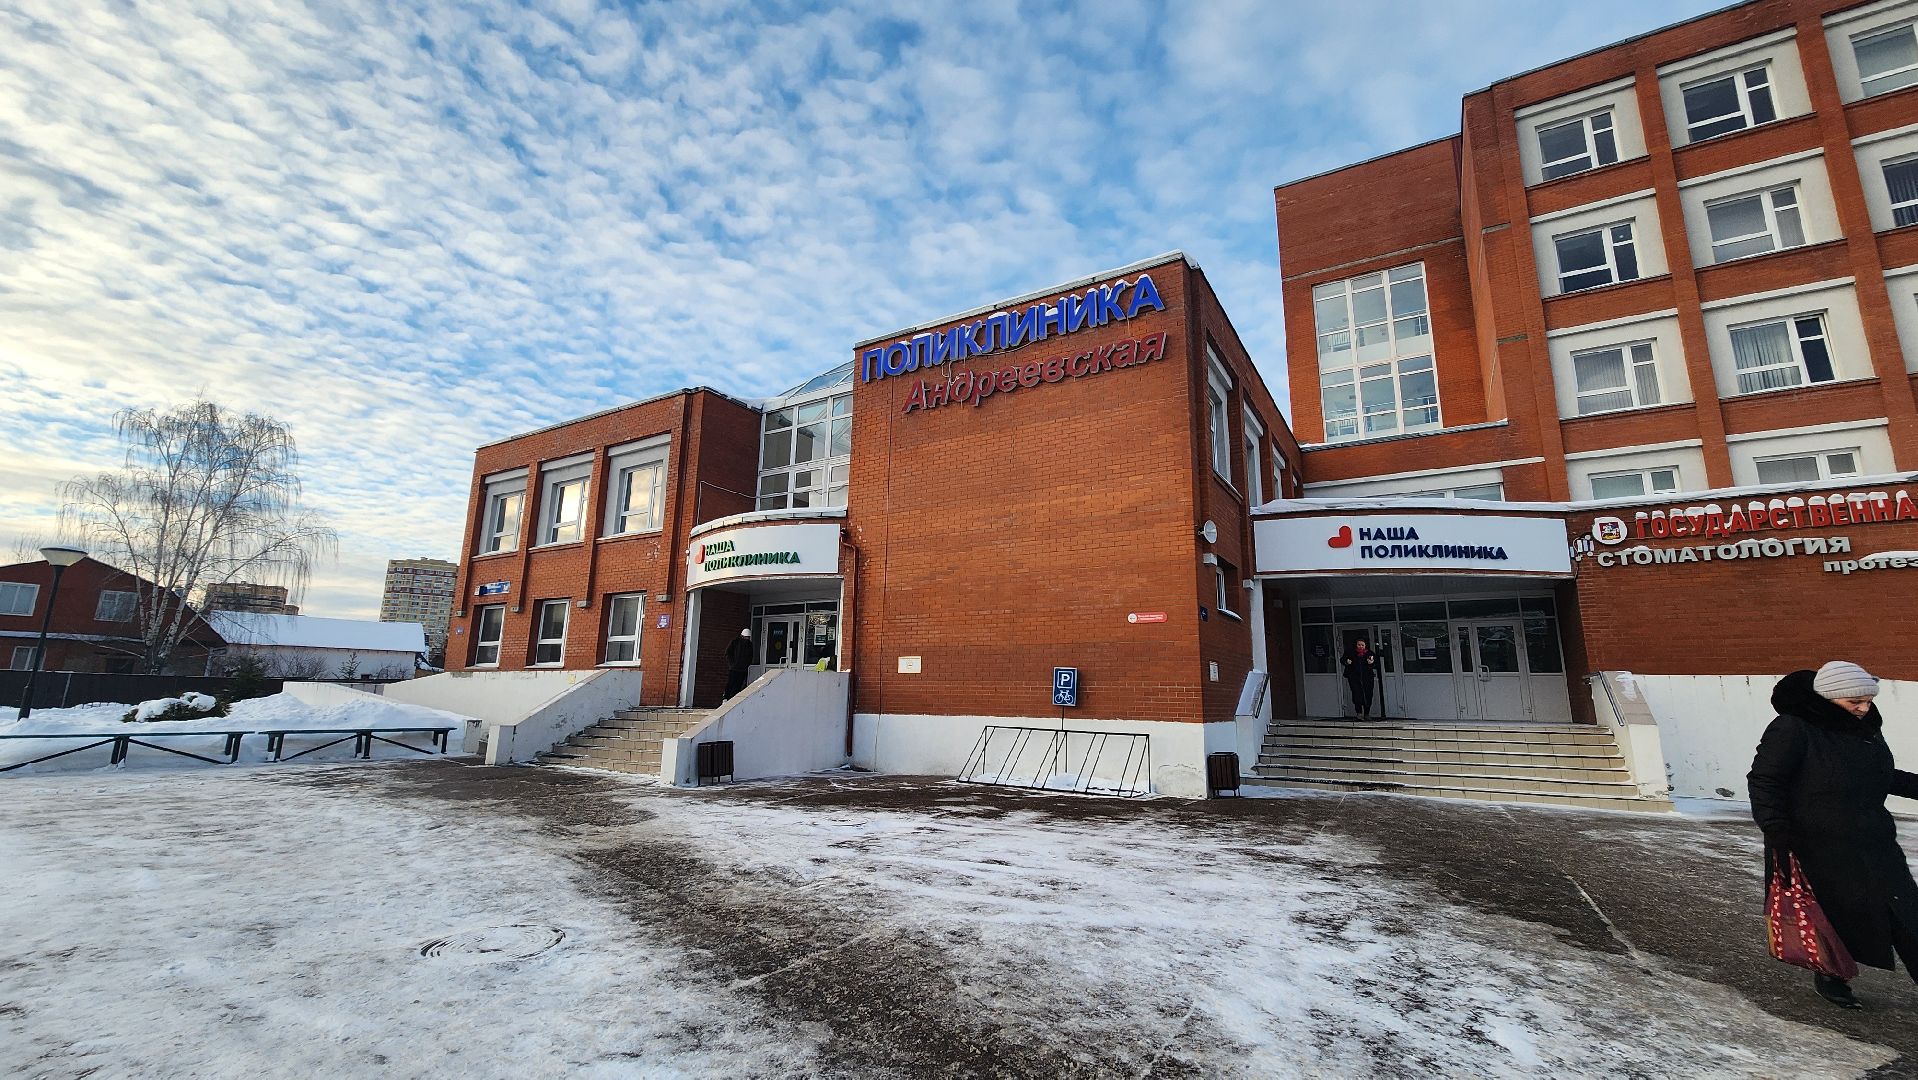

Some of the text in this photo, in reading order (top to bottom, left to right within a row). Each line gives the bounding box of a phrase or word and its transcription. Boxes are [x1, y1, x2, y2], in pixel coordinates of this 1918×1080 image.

[861, 274, 1165, 382] ПОЛИКЛИНИКА
[901, 331, 1168, 414] Андреевская
[1635, 492, 1918, 539] ГОСУДАРСТВЕННА
[1359, 527, 1419, 541] НАША
[704, 551, 800, 572] ПОЛИКЛИНИКА
[1360, 544, 1508, 560] ПОЛИКЛИНИКА
[1597, 536, 1851, 567] СТОМАТОЛОГИЯ
[1060, 673, 1071, 686] P
